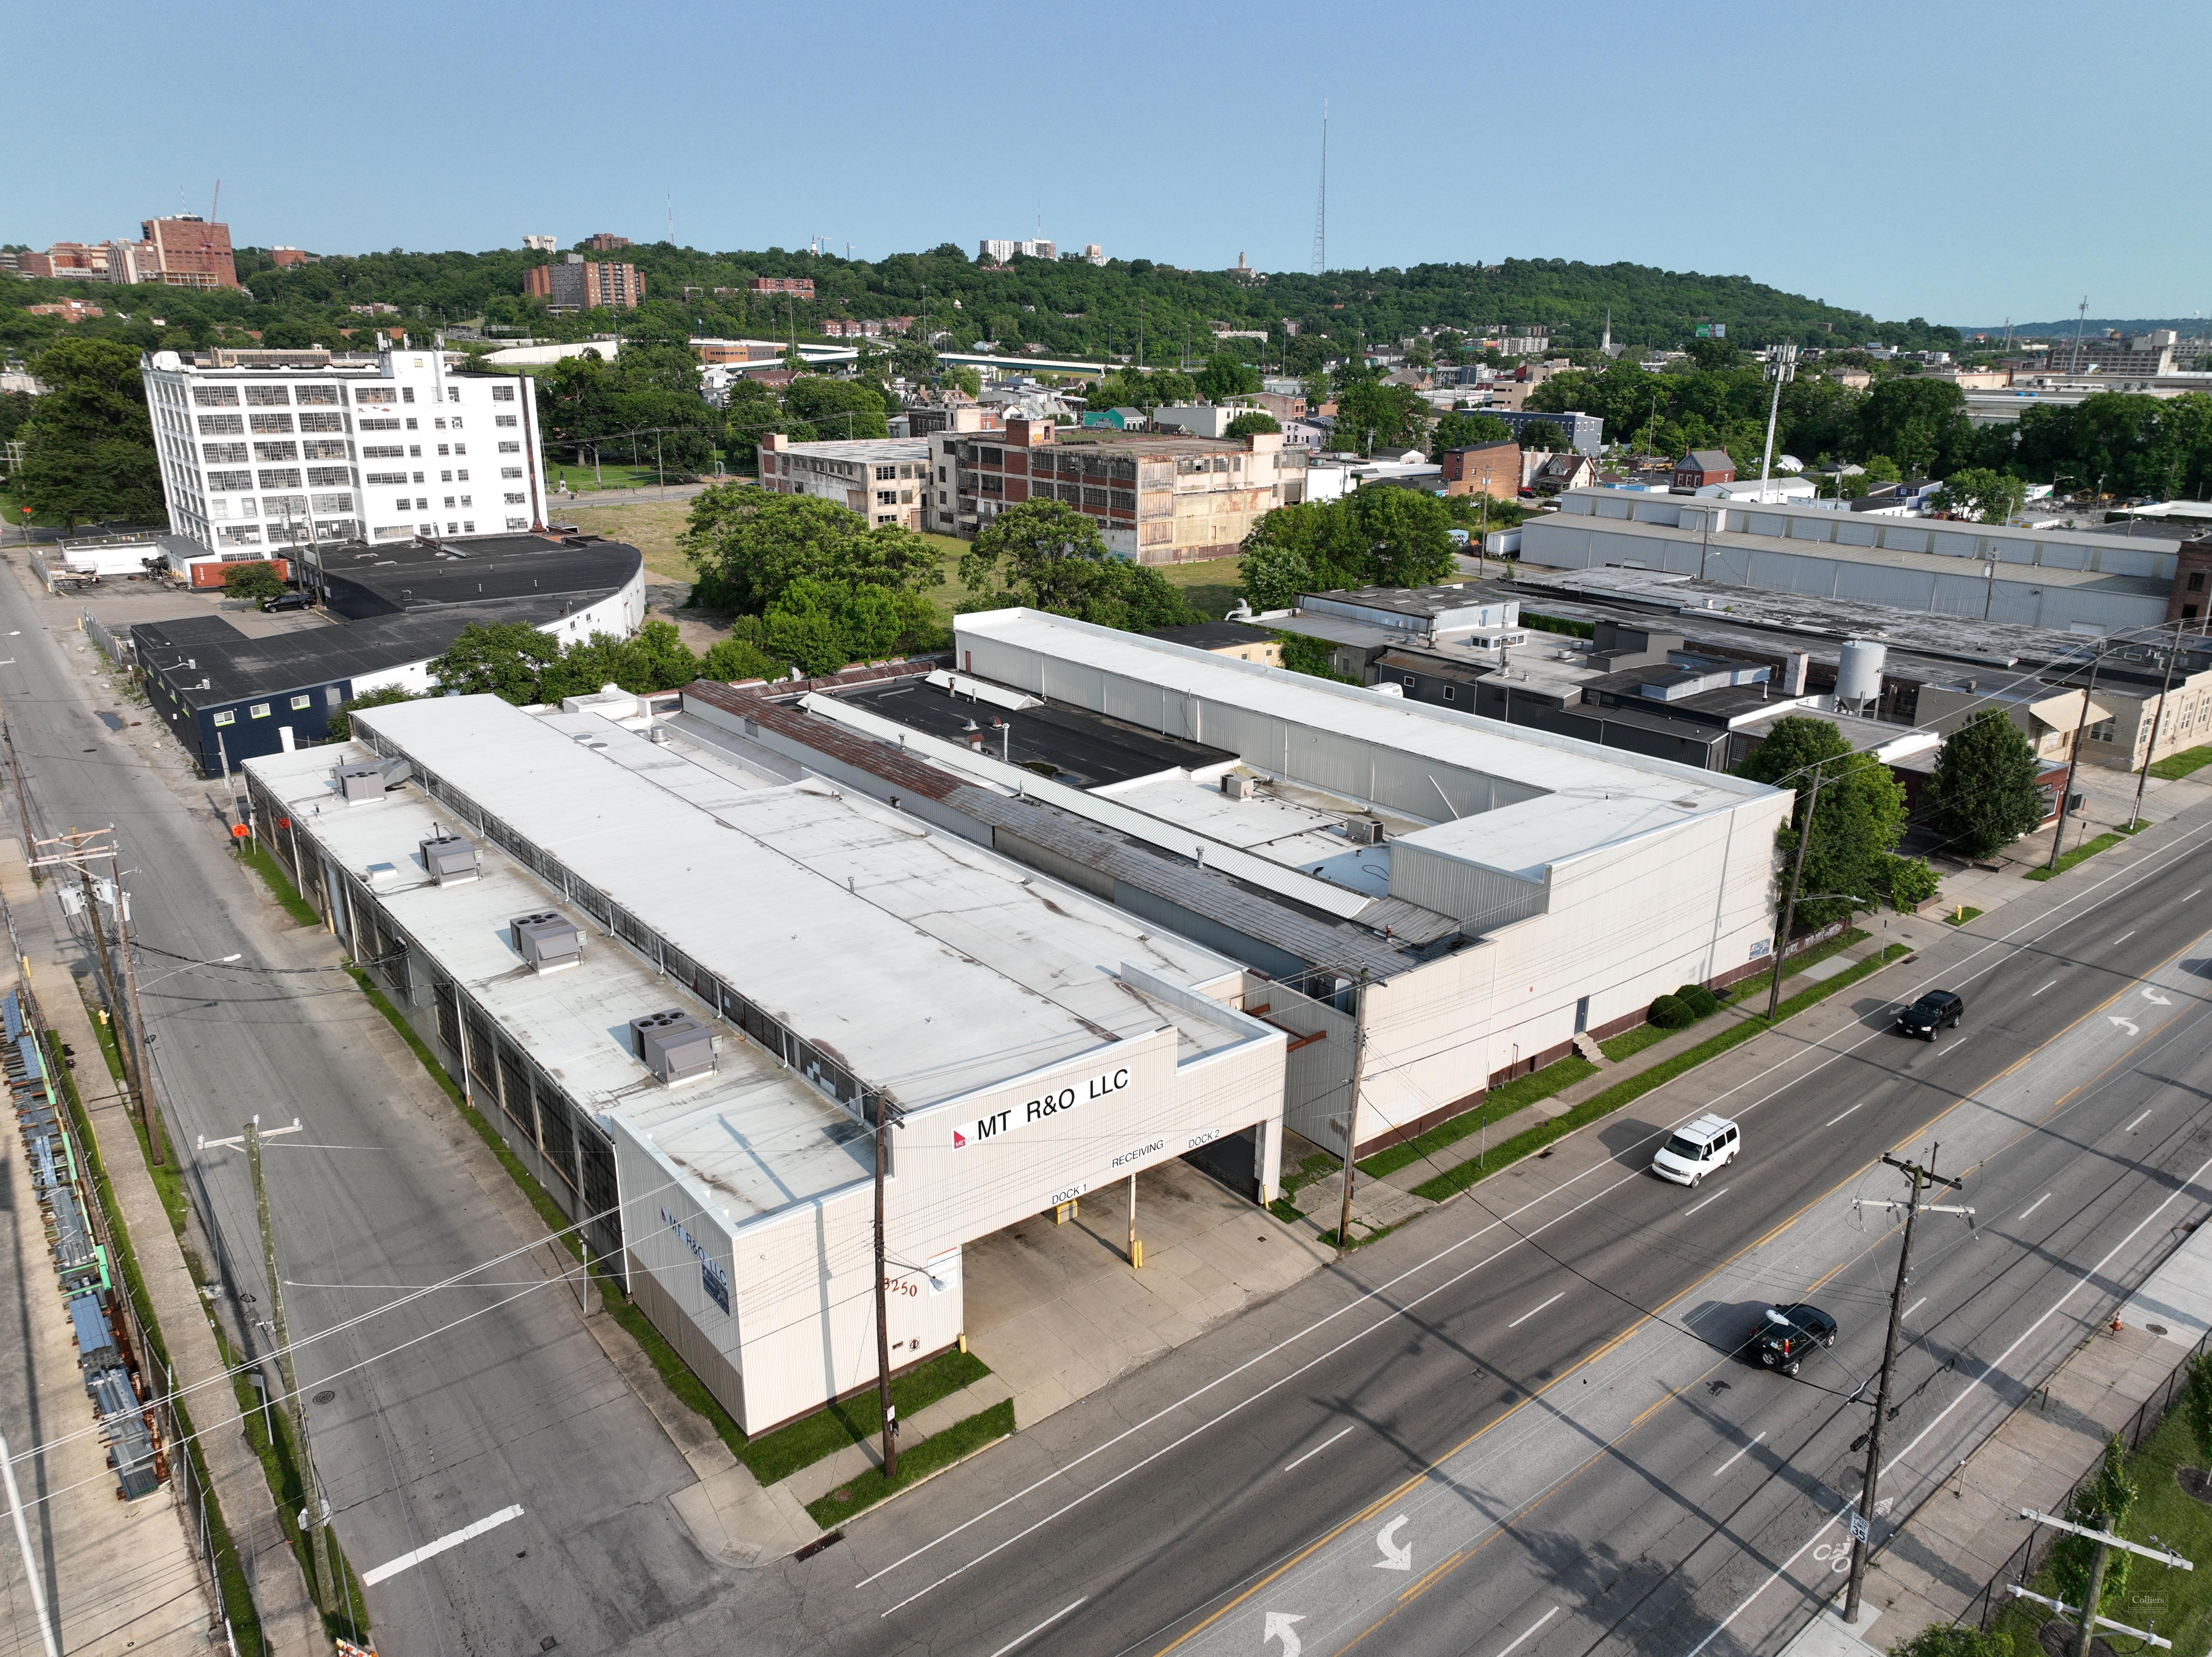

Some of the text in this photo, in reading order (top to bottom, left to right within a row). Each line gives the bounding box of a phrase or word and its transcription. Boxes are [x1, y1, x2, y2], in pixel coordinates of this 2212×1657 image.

[978, 1069, 1128, 1140] MT R&O LLC
[956, 1136, 975, 1147] MEYER
[1189, 1129, 1220, 1149] DOCK 2
[1112, 1140, 1164, 1168] RECEIVING
[1052, 1183, 1087, 1205] DOCK 1
[669, 1214, 681, 1236] MT
[686, 1232, 705, 1262] R&O
[709, 1257, 726, 1286] LLC
[1853, 1513, 1868, 1528] SPEED
[1853, 1519, 1866, 1531] LIMIT
[1852, 1525, 1866, 1541] 35
